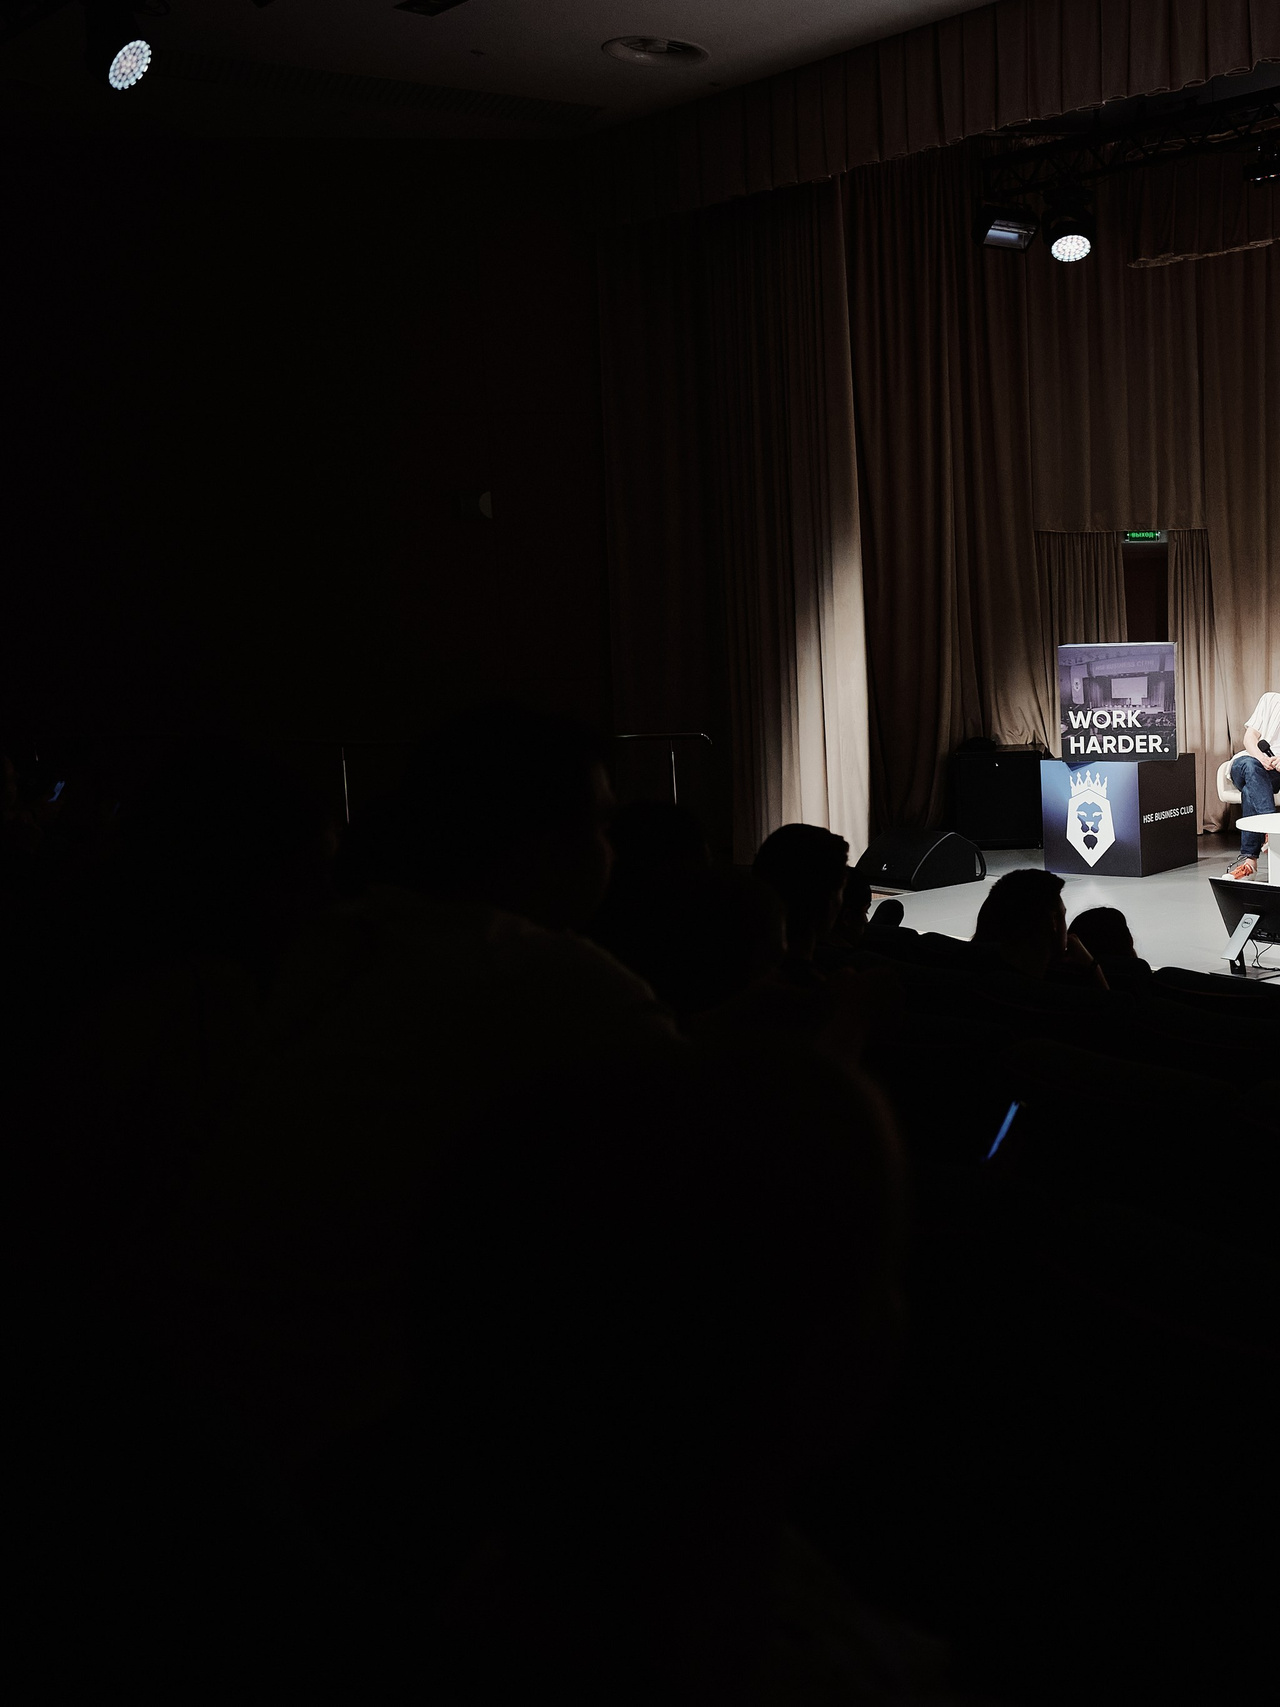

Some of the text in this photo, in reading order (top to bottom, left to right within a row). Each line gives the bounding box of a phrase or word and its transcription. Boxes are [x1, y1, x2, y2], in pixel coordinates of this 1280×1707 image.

[1068, 710, 1142, 729] WORK
[1070, 735, 1170, 754] HARDER.
[1143, 805, 1194, 823] HSE BUSINESS CLUB
